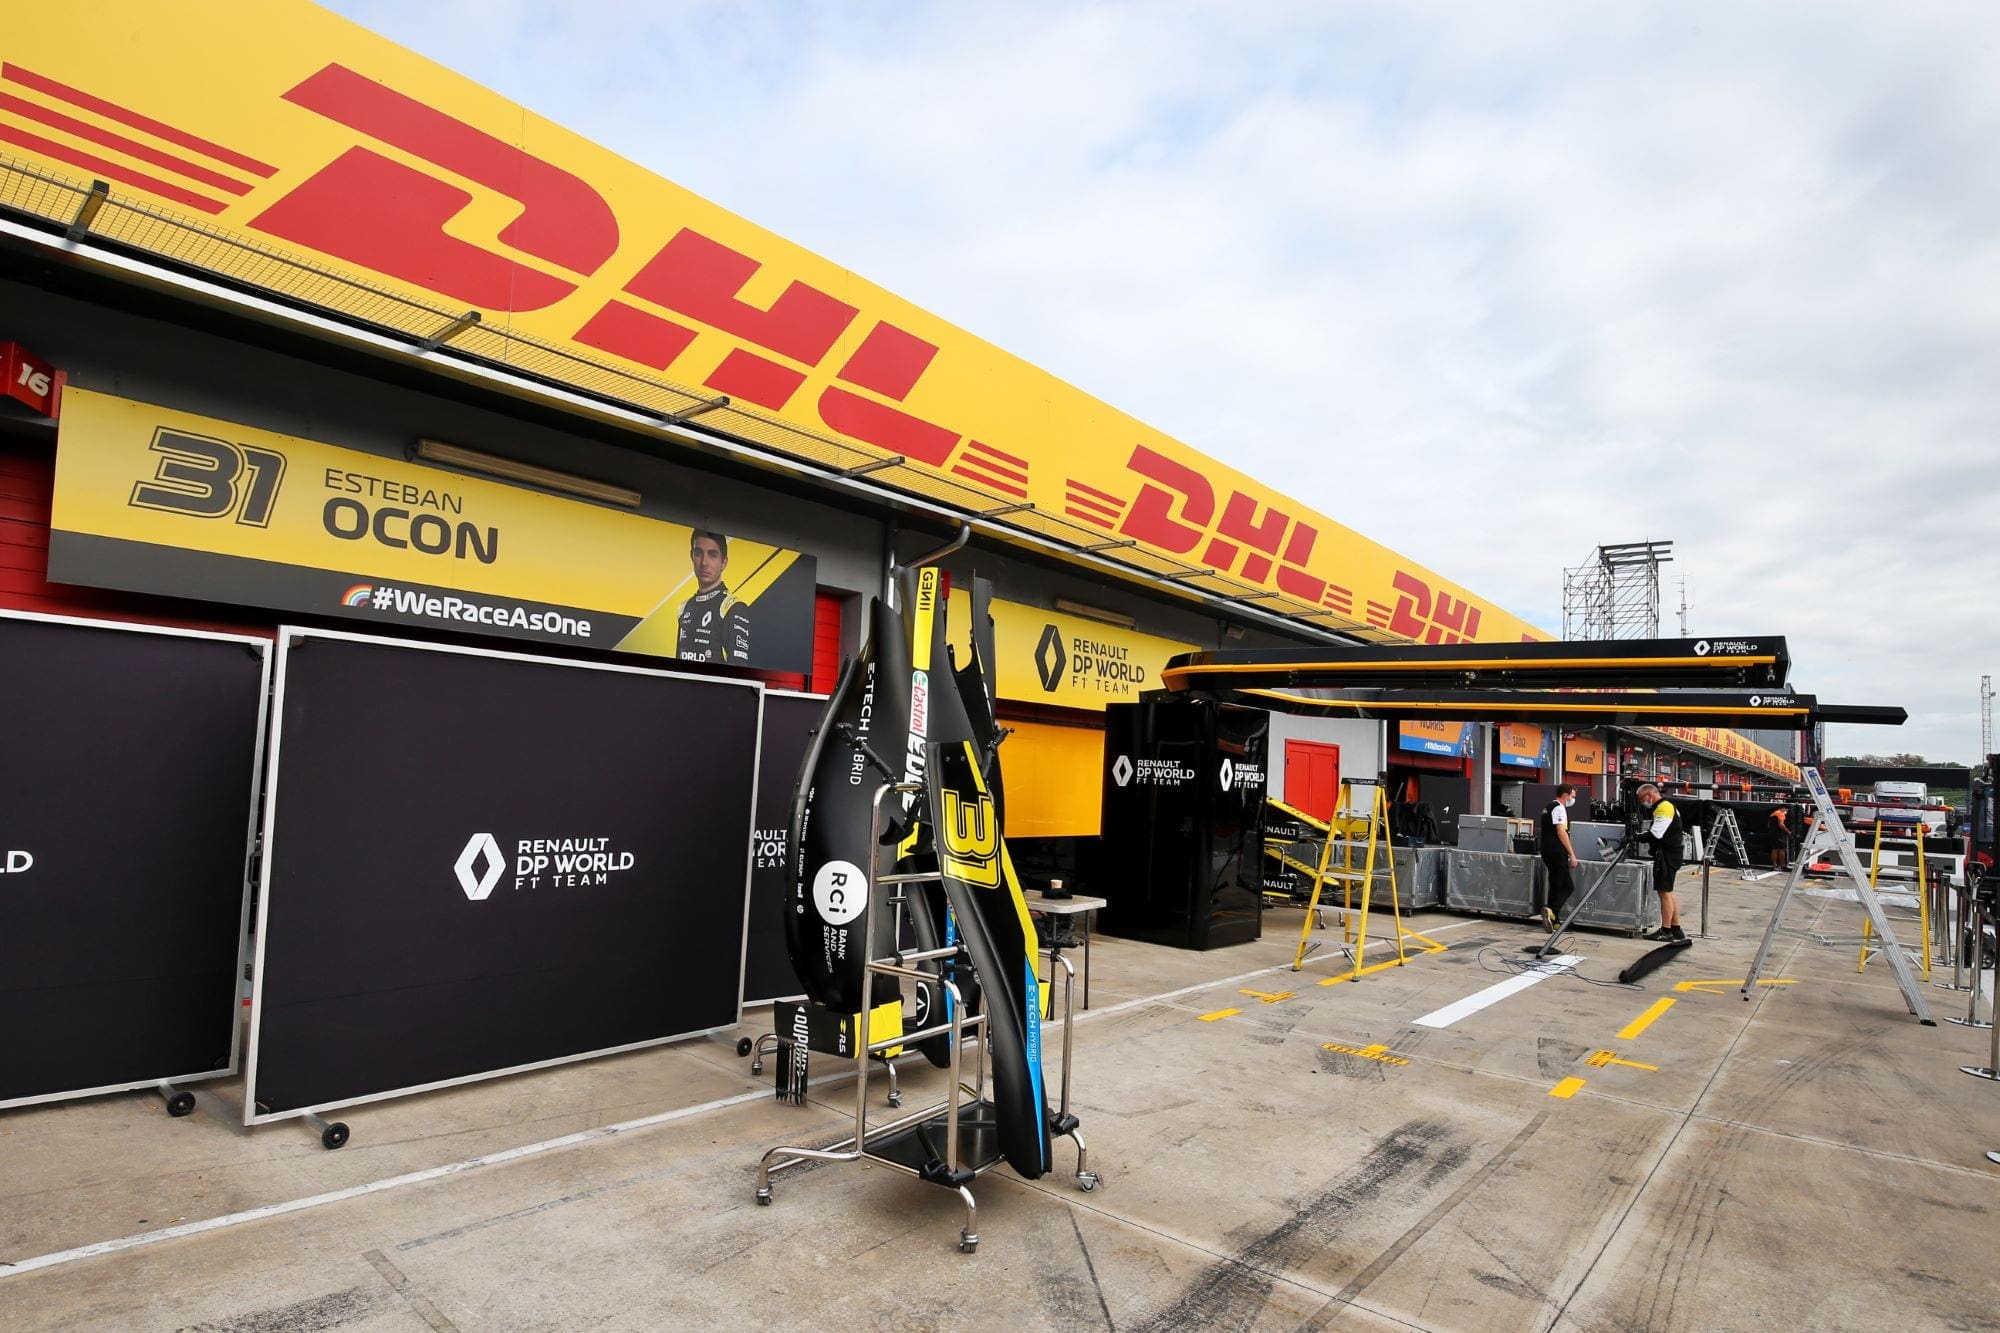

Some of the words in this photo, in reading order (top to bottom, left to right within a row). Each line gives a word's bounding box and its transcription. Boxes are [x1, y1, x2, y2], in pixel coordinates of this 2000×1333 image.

[246, 62, 962, 468] DHL
[17, 362, 52, 397] 16
[128, 425, 288, 529] 31
[324, 468, 462, 514] ESTEBAN
[322, 496, 499, 565] OCON
[1120, 444, 1327, 604] DHL
[372, 585, 592, 638] #WeRaceAsOne
[1073, 638, 1128, 660] RENAULT
[1073, 655, 1093, 675] DP
[1096, 658, 1145, 684] WORLD
[858, 661, 876, 731] E-TECH
[1096, 679, 1129, 695] TEAM
[912, 684, 926, 734] Castrol
[849, 736, 868, 786] HBRID
[1136, 767, 1152, 777] DP
[1153, 768, 1195, 780] WORLD
[1137, 759, 1181, 769] RENAULT
[1235, 763, 1259, 772] RENAULT
[1153, 778, 1181, 786] TEAM
[1234, 771, 1244, 781] DP
[1245, 772, 1265, 783] WORLD
[517, 838, 609, 854] RENAULT
[941, 788, 1001, 889] 31
[1265, 825, 1296, 836] NAULT
[516, 855, 549, 875] DP
[554, 852, 635, 873] WORLD
[553, 873, 608, 888] TEAM
[828, 872, 848, 914] RCi
[823, 925, 834, 975] SERVICES
[830, 927, 838, 952] AND
[838, 928, 848, 960] BANK
[1028, 984, 1037, 1029] E-TECH
[838, 1033, 847, 1054] RS
[1030, 1032, 1038, 1063] HYBRID
